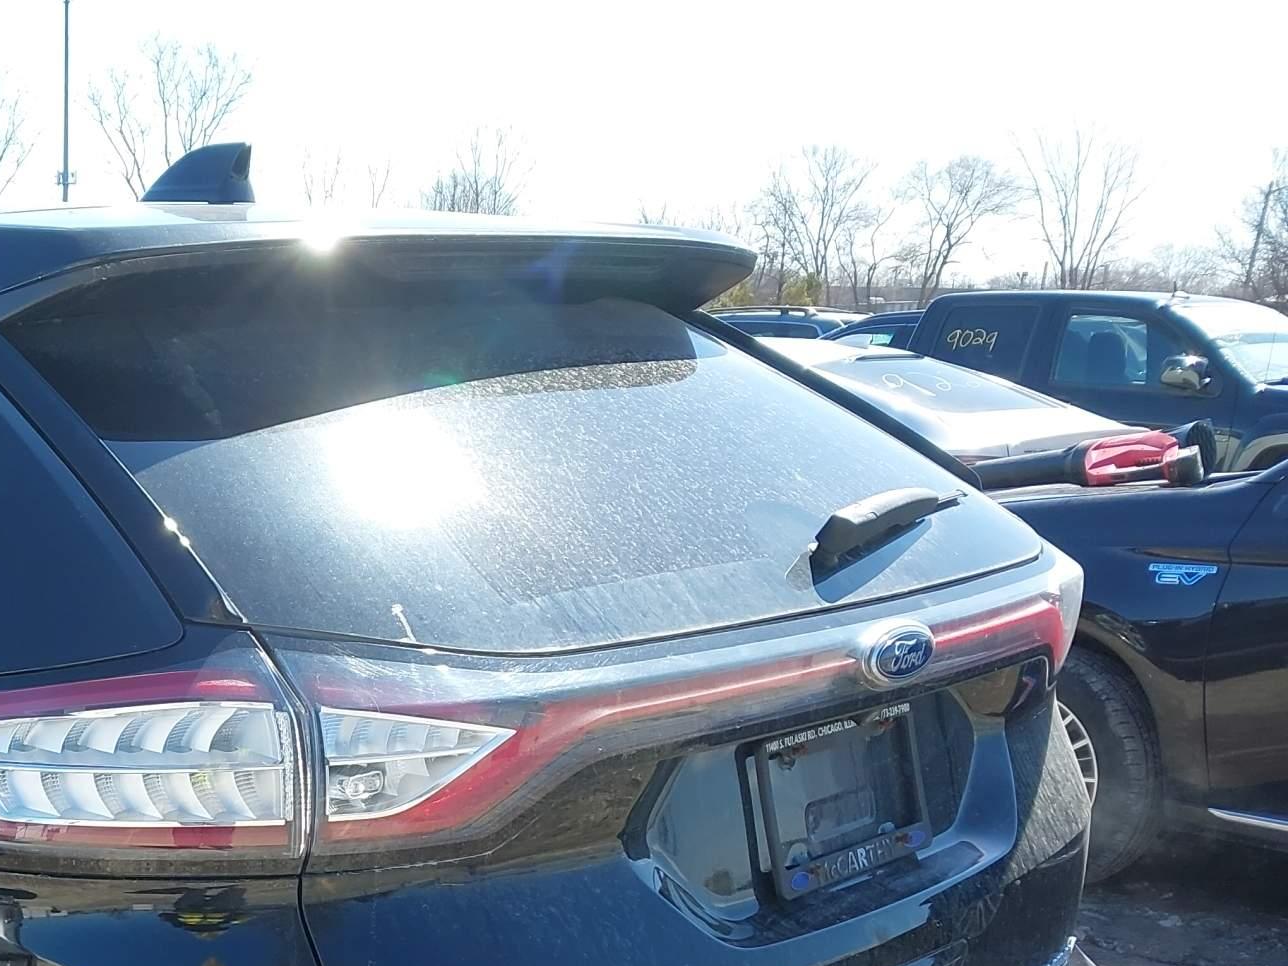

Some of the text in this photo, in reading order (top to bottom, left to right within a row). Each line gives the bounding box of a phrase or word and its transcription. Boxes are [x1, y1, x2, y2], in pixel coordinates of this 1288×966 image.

[946, 328, 999, 352] 9029
[1156, 571, 1207, 585] EV
[890, 637, 927, 673] Ford
